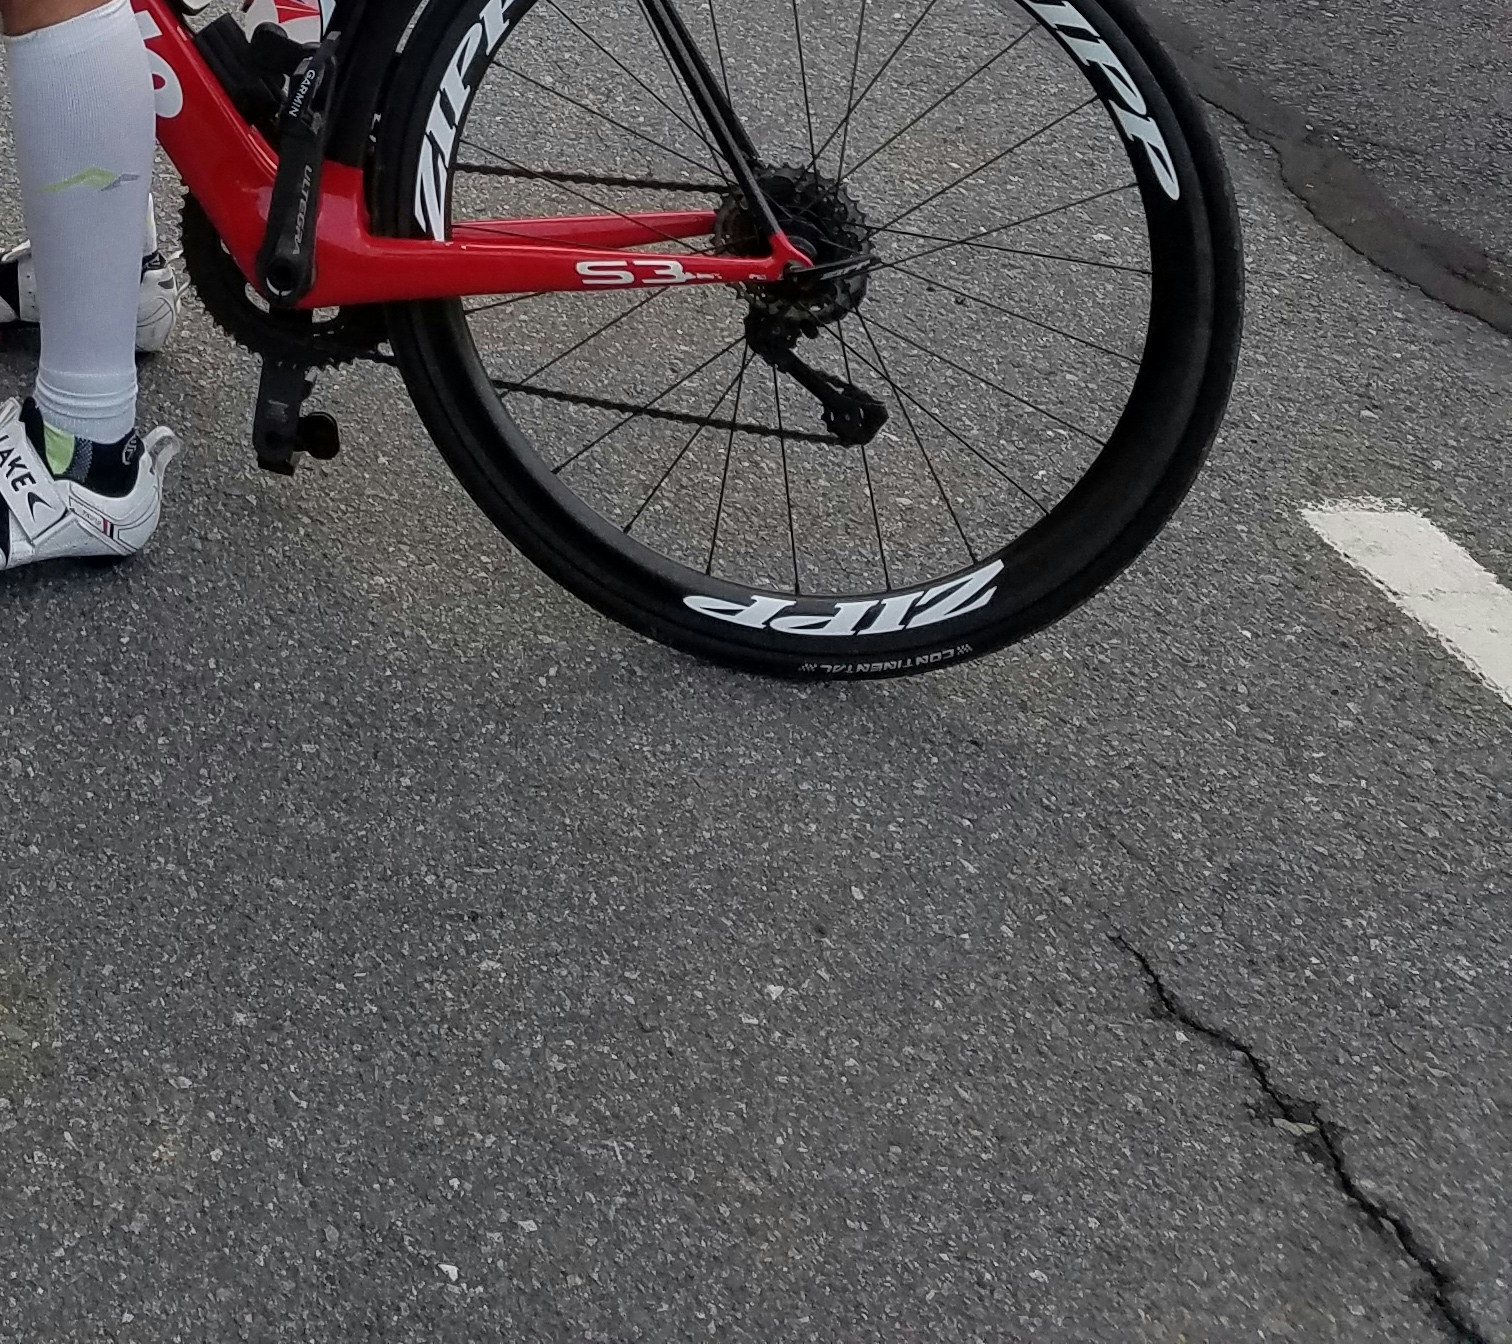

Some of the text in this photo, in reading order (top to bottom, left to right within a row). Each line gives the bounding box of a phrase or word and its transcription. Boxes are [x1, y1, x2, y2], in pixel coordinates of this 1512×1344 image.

[289, 68, 316, 118] GARMIN
[292, 164, 313, 256] ULTEGRA
[576, 259, 687, 285] S3
[682, 559, 1007, 638] ZIPP
[819, 648, 955, 674] CONTINENTAL
